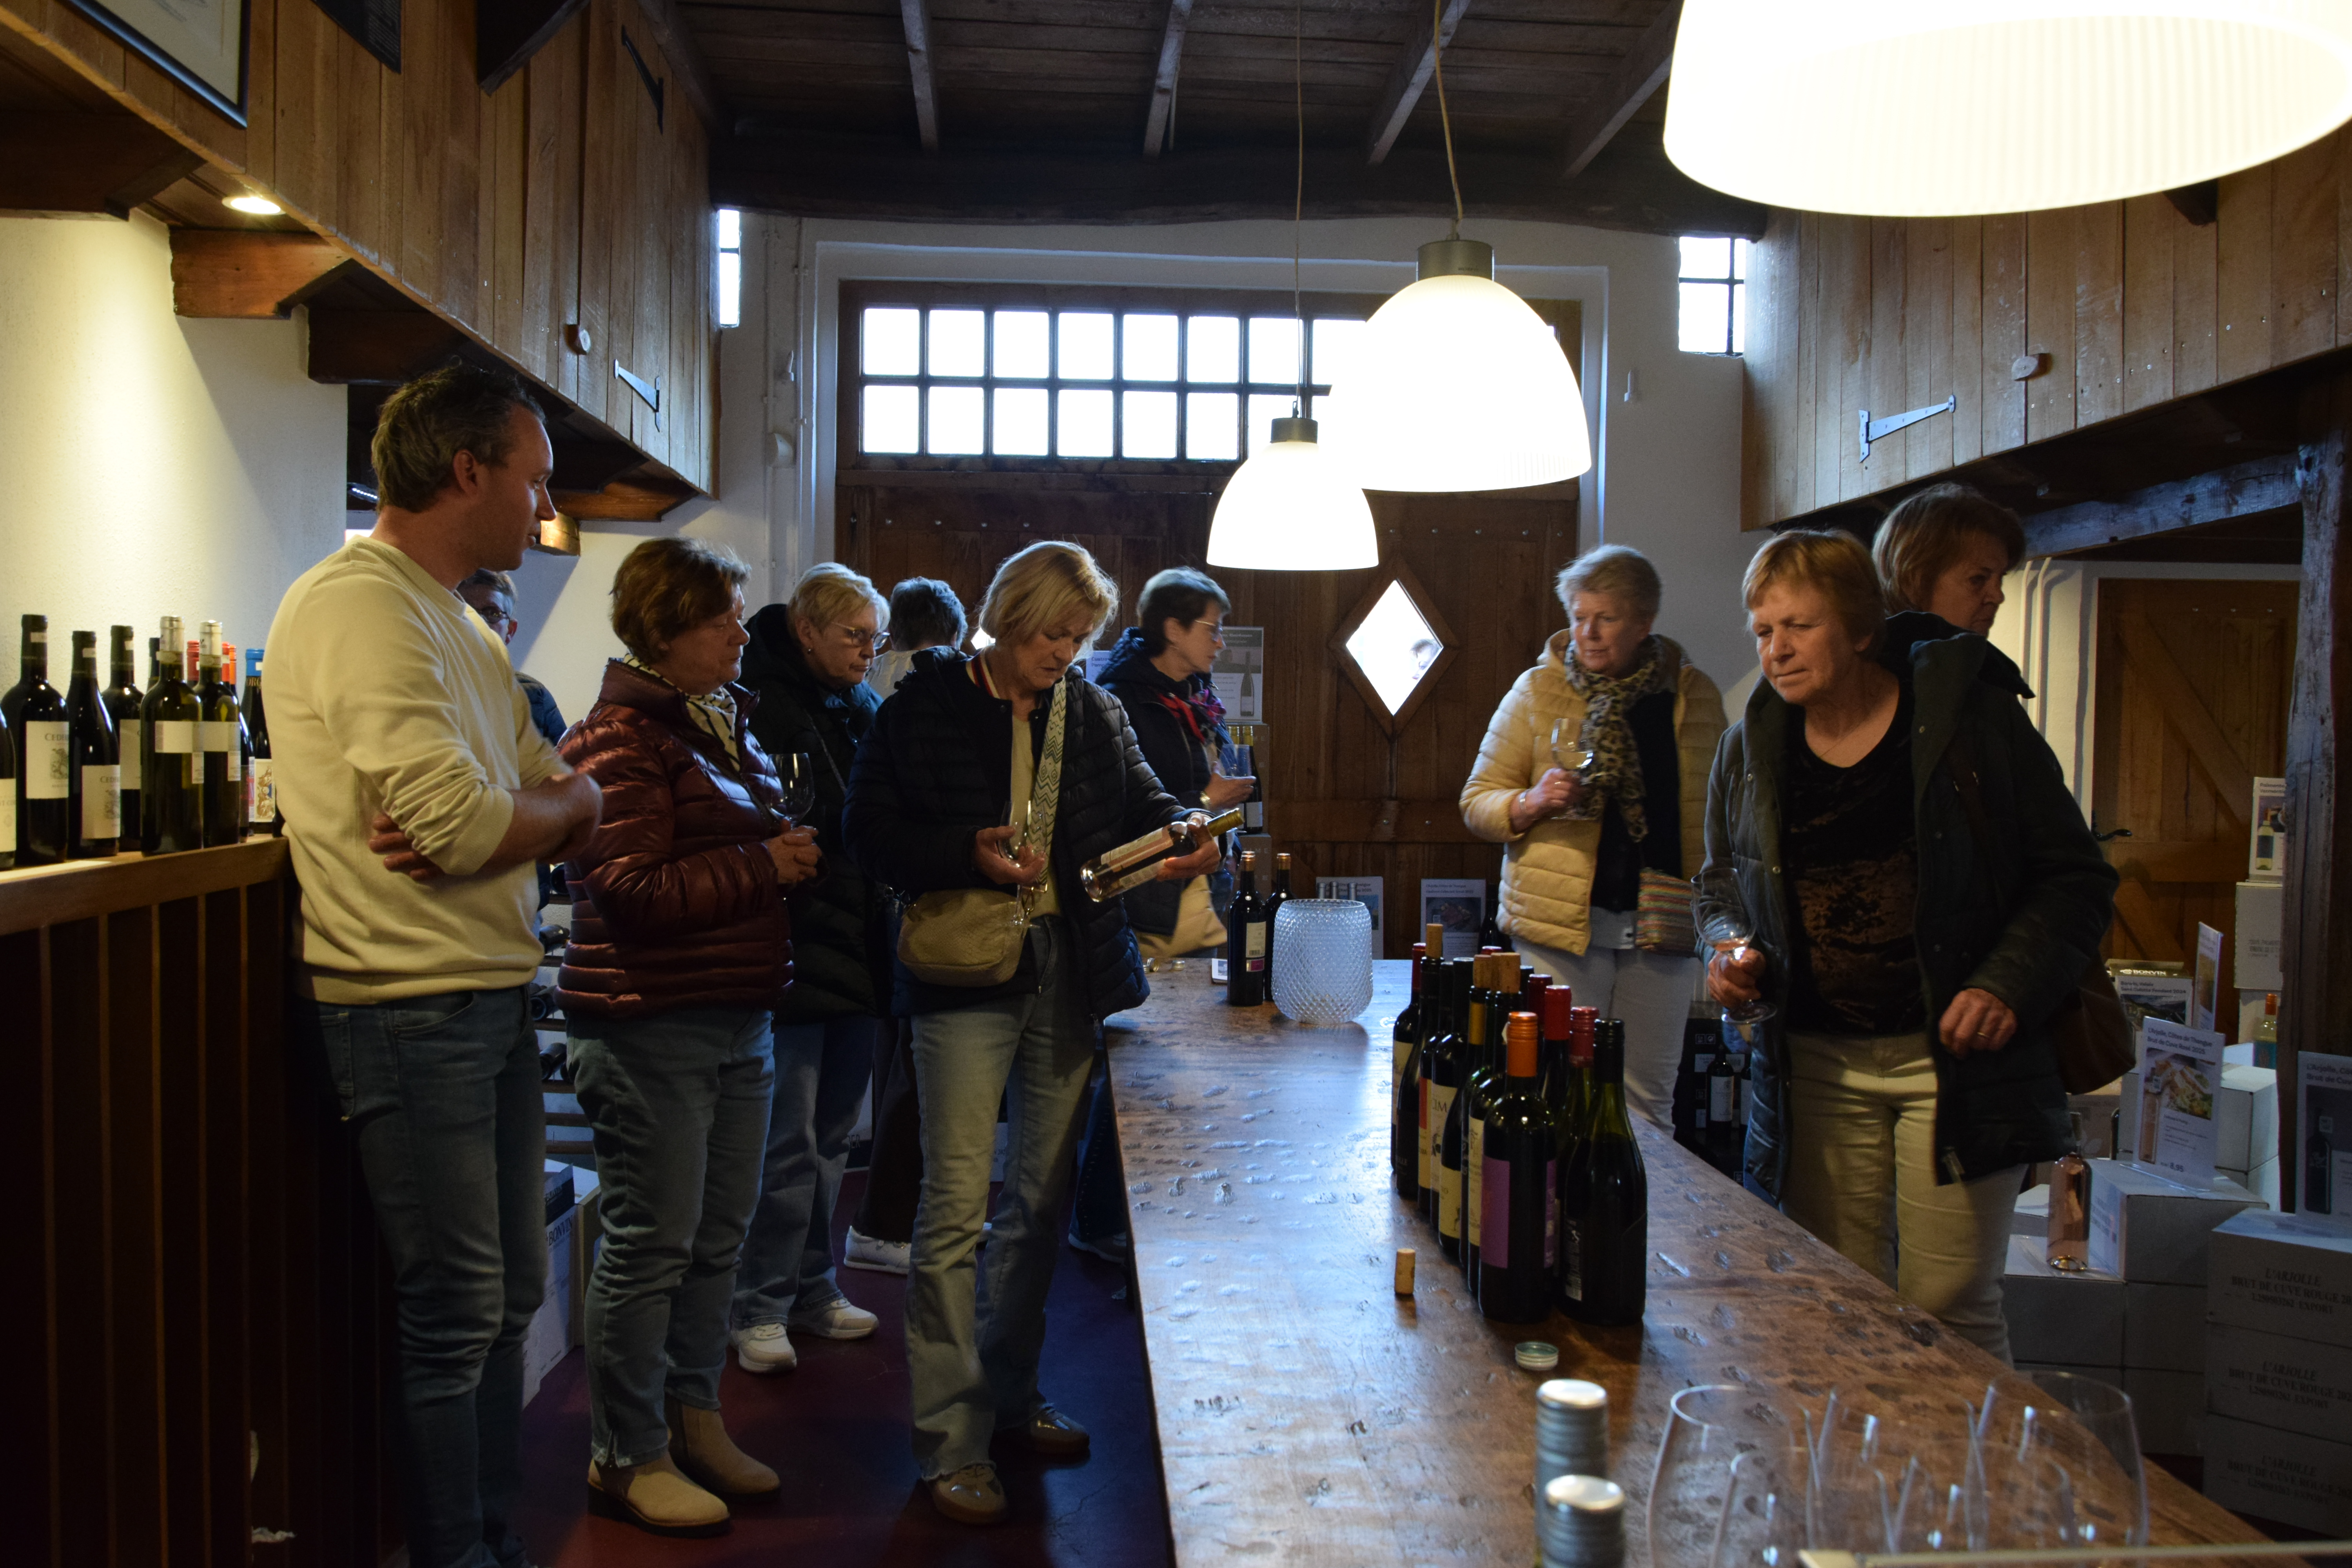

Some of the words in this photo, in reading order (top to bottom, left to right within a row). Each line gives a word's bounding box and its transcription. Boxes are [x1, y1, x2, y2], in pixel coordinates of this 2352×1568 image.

[2306, 1073, 2323, 1082] Brut
[549, 1214, 573, 1247] BONVIN
[2265, 1267, 2321, 1287] L'ARJOLLE
[2232, 1276, 2256, 1289] BRUT
[2259, 1280, 2271, 1292] DE
[2274, 1283, 2301, 1297] CUVE
[2303, 1288, 2340, 1304] ROUGE
[2299, 1300, 2333, 1314] EXPORT
[2263, 1361, 2316, 1381] L'ARJOLLE
[2229, 1367, 2253, 1382] BRUT
[2256, 1373, 2268, 1385] DE
[2271, 1377, 2298, 1390] CUVE
[2299, 1382, 2334, 1398] ROUGE
[2295, 1394, 2328, 1409] EXPORT
